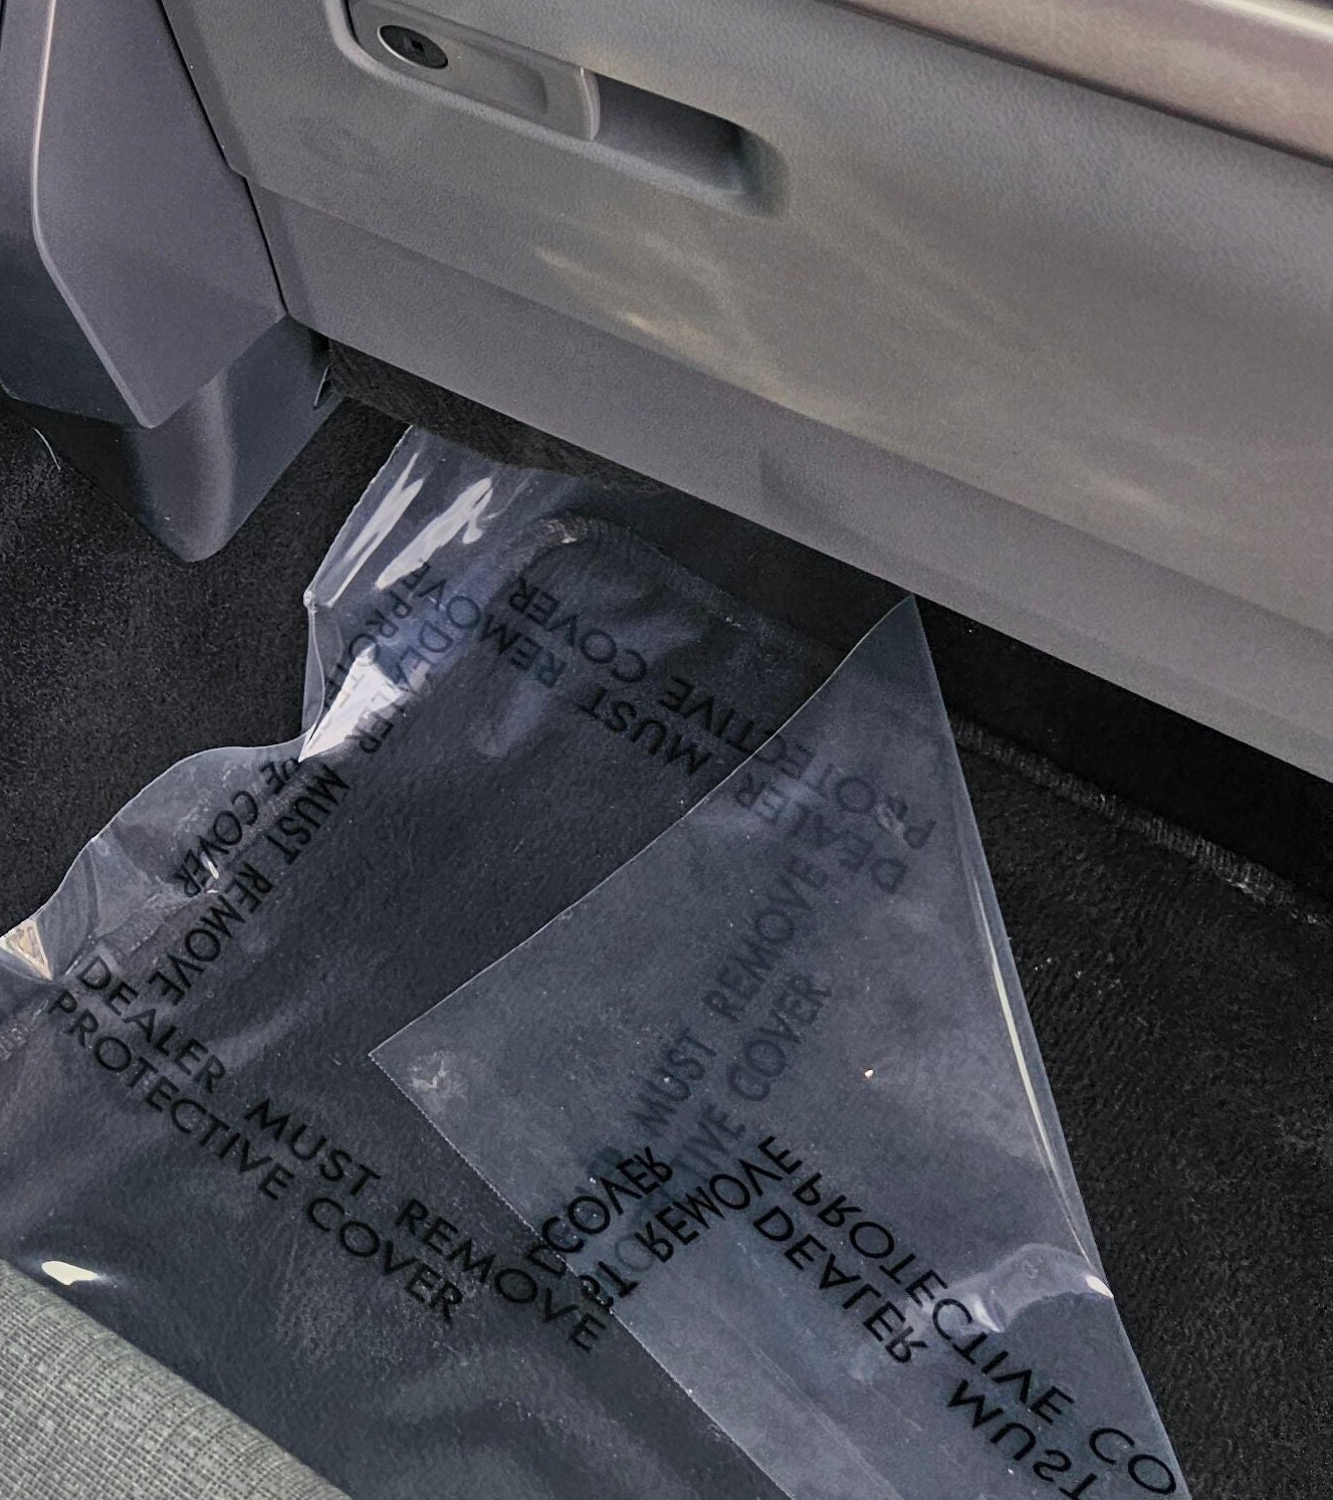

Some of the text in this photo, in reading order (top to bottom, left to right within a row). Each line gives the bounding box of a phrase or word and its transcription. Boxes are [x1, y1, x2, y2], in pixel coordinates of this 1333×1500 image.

[508, 576, 647, 684] COVER
[576, 686, 714, 777] MUST
[174, 790, 259, 899] COVER
[265, 763, 351, 866] MUST
[148, 861, 274, 1006] REMOVE
[731, 973, 831, 1102] COVER
[47, 989, 296, 1202] PROTECTIVE
[306, 1198, 464, 1326] COVER
[76, 955, 228, 1095] DEALER
[242, 1096, 382, 1198] MUST
[394, 1198, 608, 1353] REMOVE
